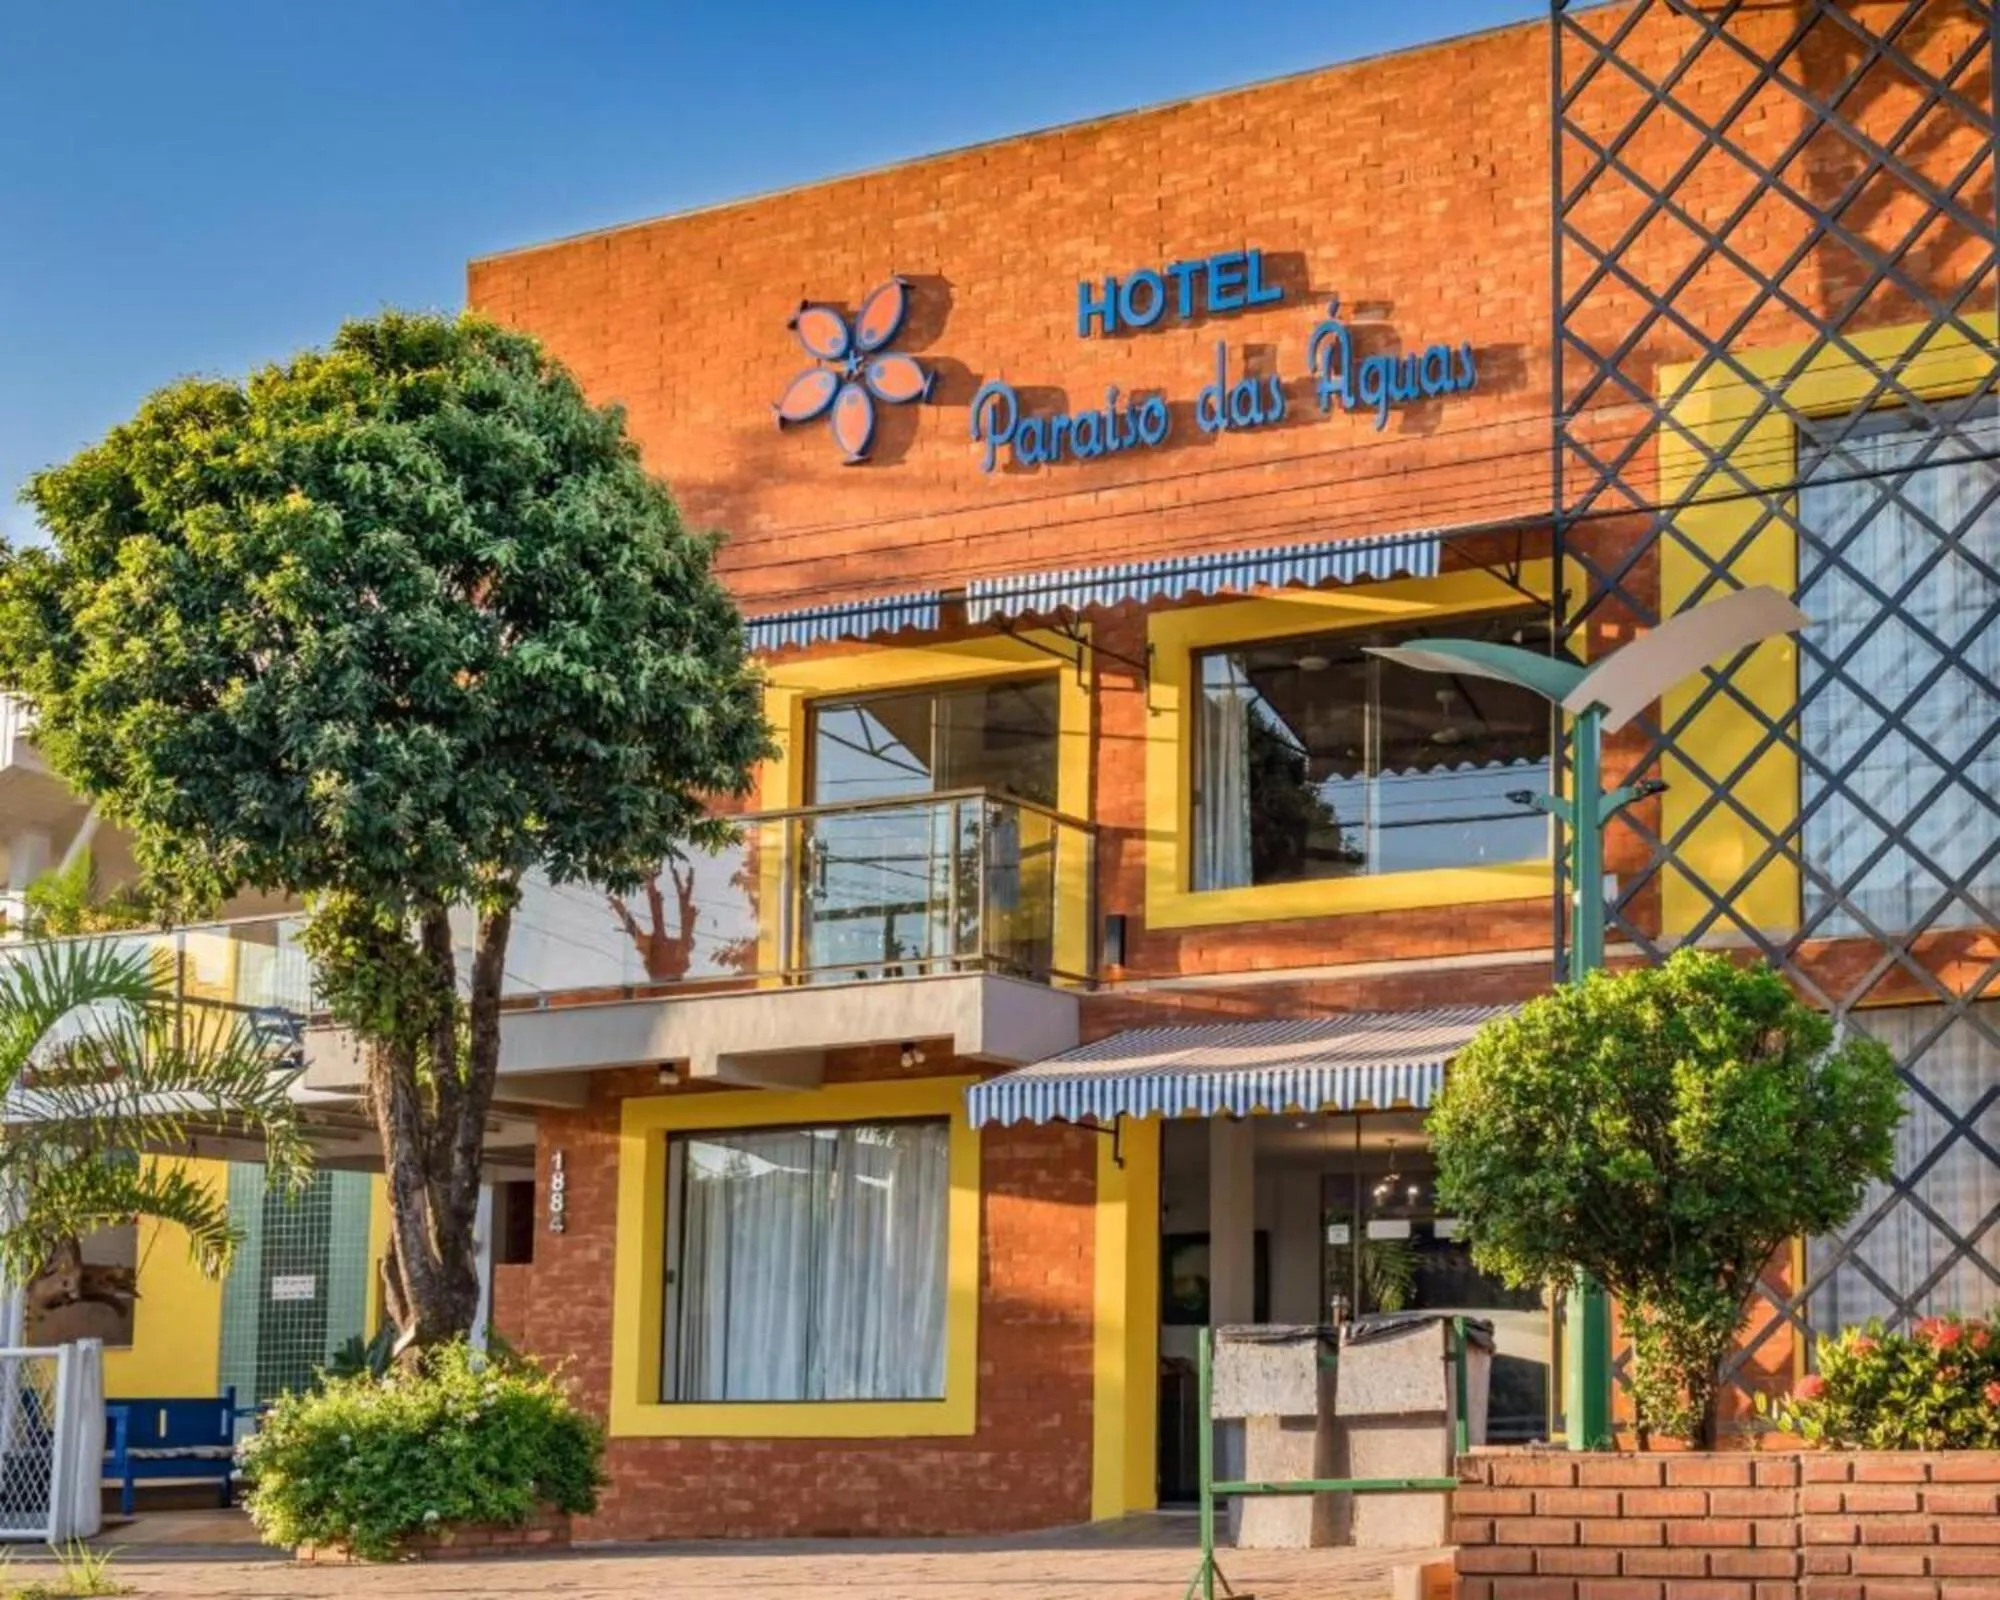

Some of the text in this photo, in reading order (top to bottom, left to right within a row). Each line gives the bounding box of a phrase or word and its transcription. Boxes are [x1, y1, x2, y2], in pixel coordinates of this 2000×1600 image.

[1076, 248, 1284, 337] HOTEL
[1195, 340, 1285, 433] das
[1308, 299, 1477, 432] Águas
[549, 1149, 565, 1234] 1884
